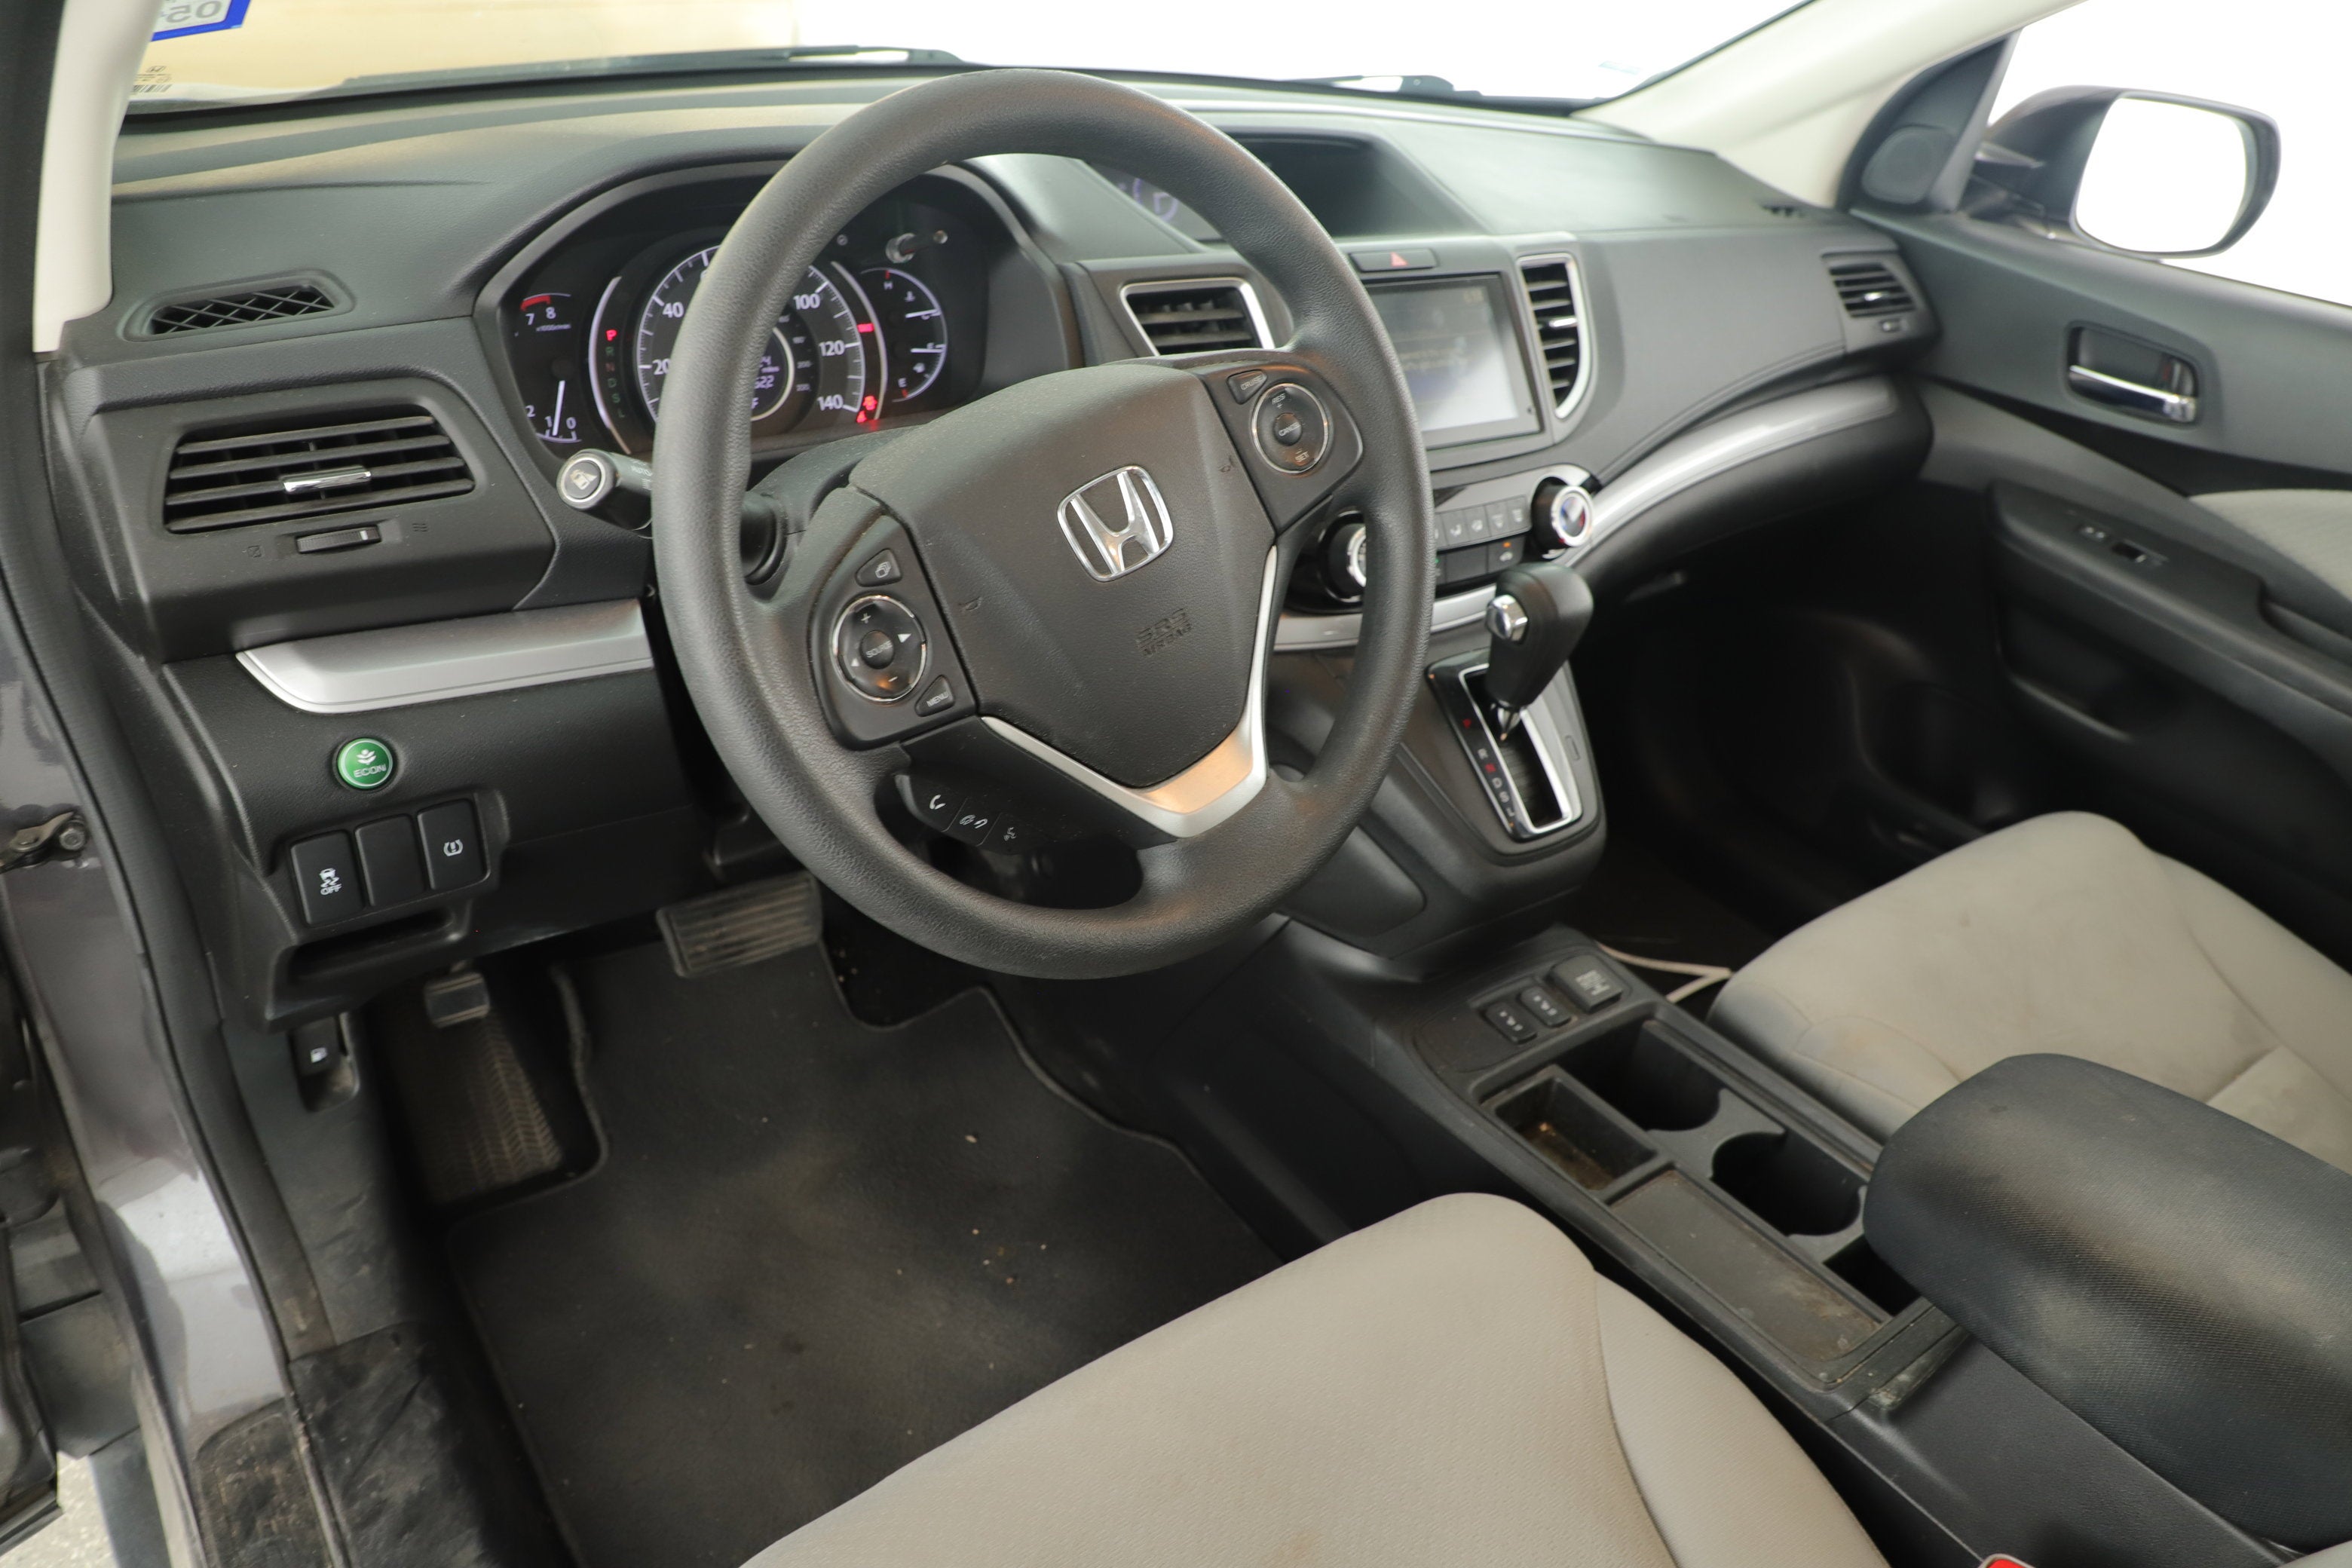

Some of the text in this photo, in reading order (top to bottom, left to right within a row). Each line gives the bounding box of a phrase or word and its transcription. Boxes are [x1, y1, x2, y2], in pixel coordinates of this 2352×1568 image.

[794, 293, 821, 310] 100
[545, 307, 556, 319] 8
[663, 302, 684, 318] 40
[525, 313, 534, 326] 7
[606, 329, 617, 341] P
[605, 346, 614, 357] R
[819, 340, 845, 357] 120
[652, 358, 670, 375] 20
[608, 378, 617, 387] D
[1240, 375, 1263, 390] CRUISE
[611, 394, 620, 403] S
[818, 394, 844, 411] 140
[1272, 394, 1286, 404] RES
[525, 405, 535, 418] 2
[545, 416, 553, 428] 1
[566, 417, 577, 429] 0
[1295, 452, 1310, 462] SET
[1136, 608, 1190, 649] SRS
[865, 639, 893, 659] SOURCE
[926, 691, 949, 707] MENU
[354, 764, 387, 778] ECON
[320, 883, 341, 896] OFF
